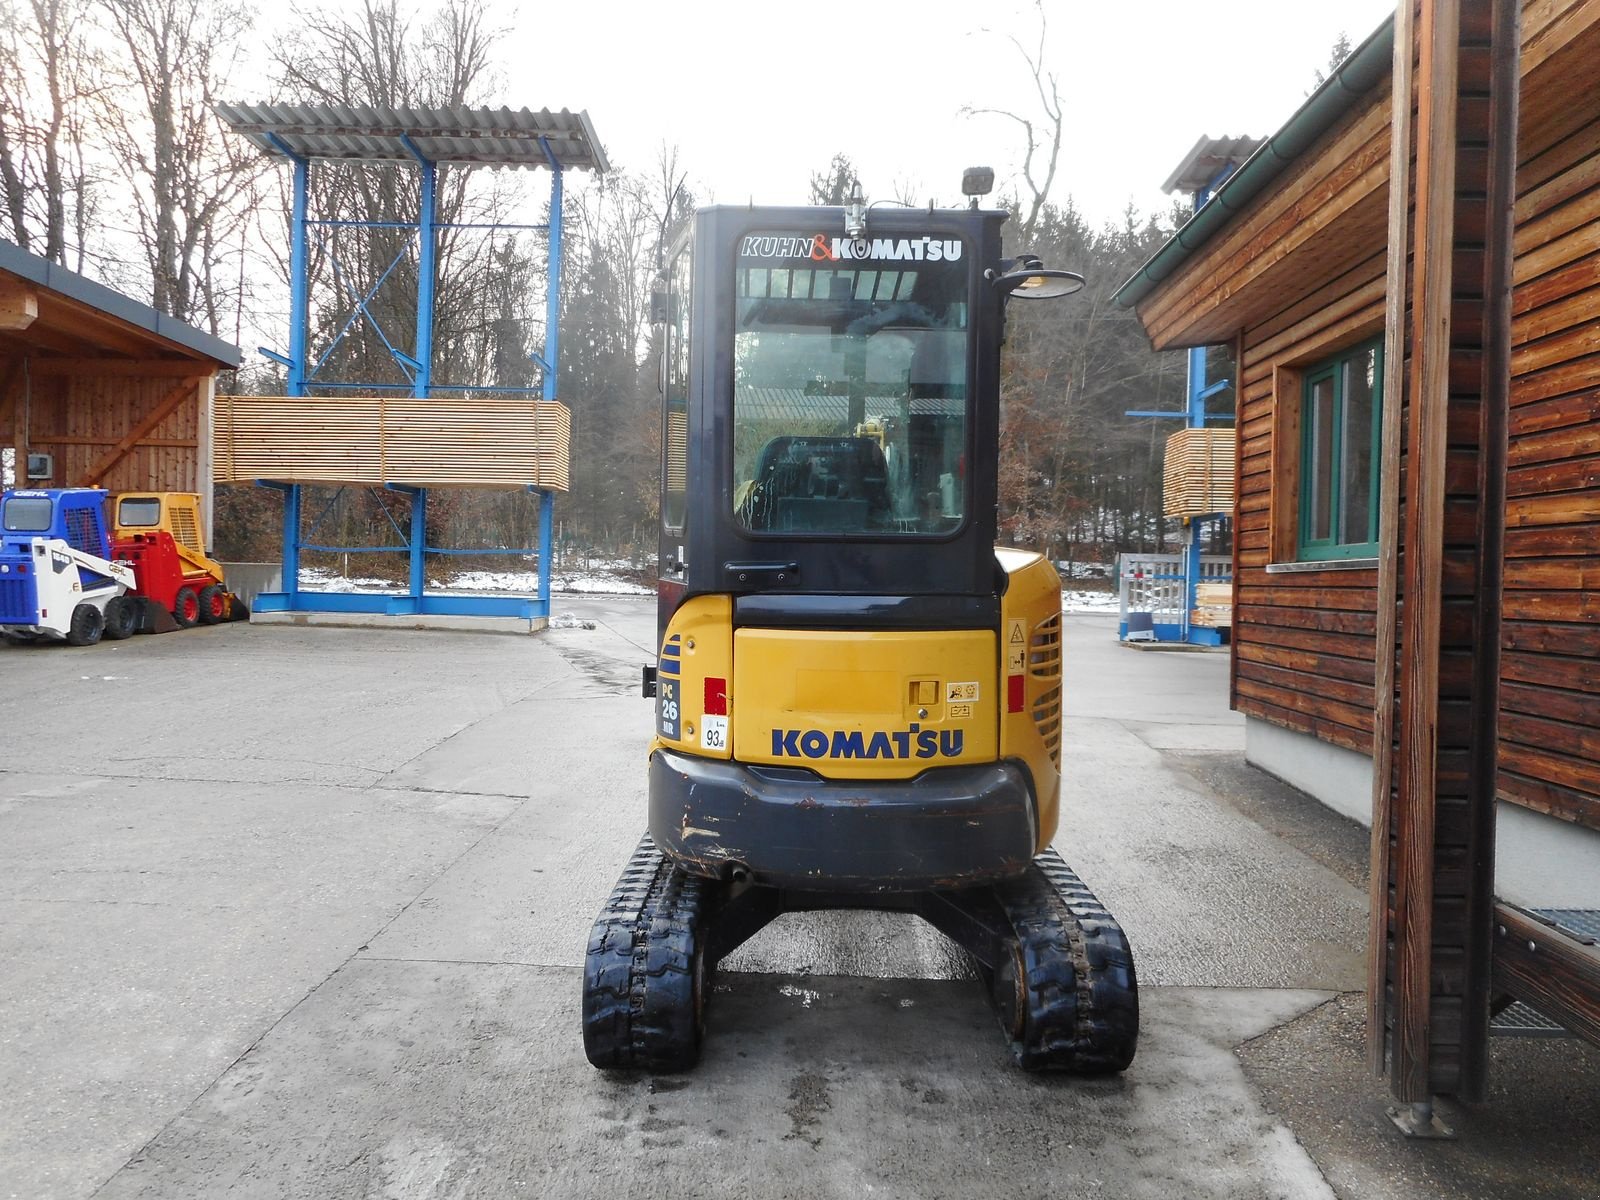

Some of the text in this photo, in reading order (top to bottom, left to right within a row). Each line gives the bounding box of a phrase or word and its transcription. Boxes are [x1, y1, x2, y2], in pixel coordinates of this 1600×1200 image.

[109, 564, 126, 577] GEHL
[662, 683, 673, 699] PC
[662, 700, 678, 720] 26
[706, 730, 719, 746] 93
[772, 723, 963, 758] KOMATSU
